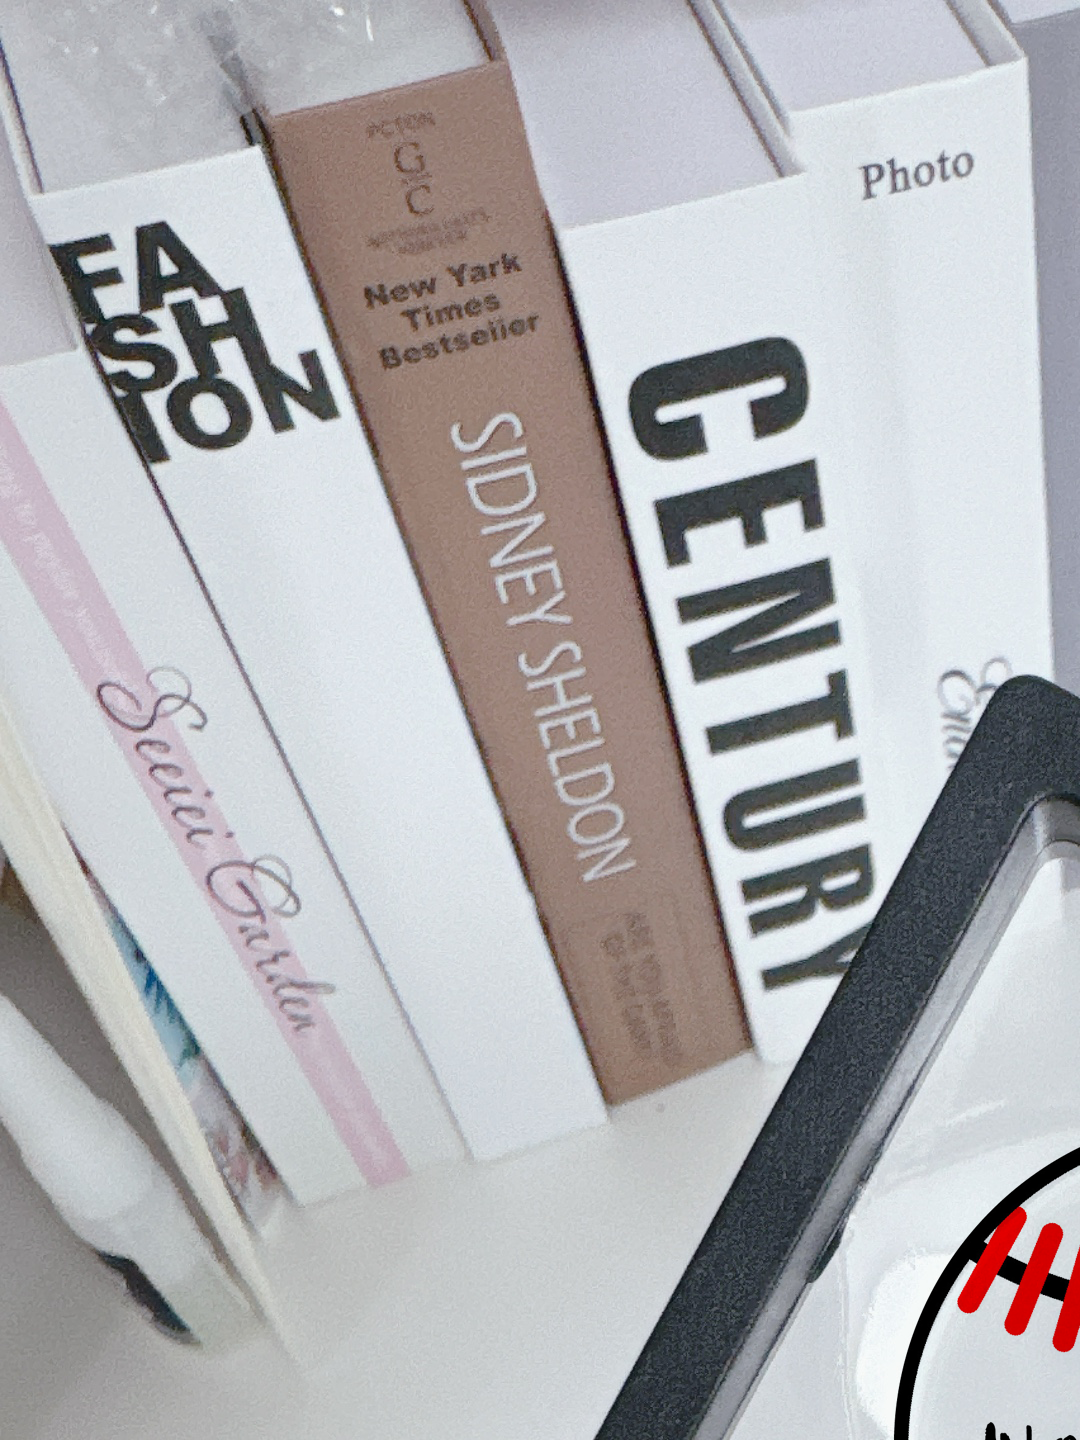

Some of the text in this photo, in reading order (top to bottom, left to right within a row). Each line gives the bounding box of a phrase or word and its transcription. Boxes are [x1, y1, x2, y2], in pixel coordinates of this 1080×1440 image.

[859, 149, 975, 201] Photo
[363, 277, 436, 309] New
[401, 293, 501, 332] Times
[450, 412, 637, 883] SIDNEY SHELDON
[628, 336, 875, 993] CENTURY
